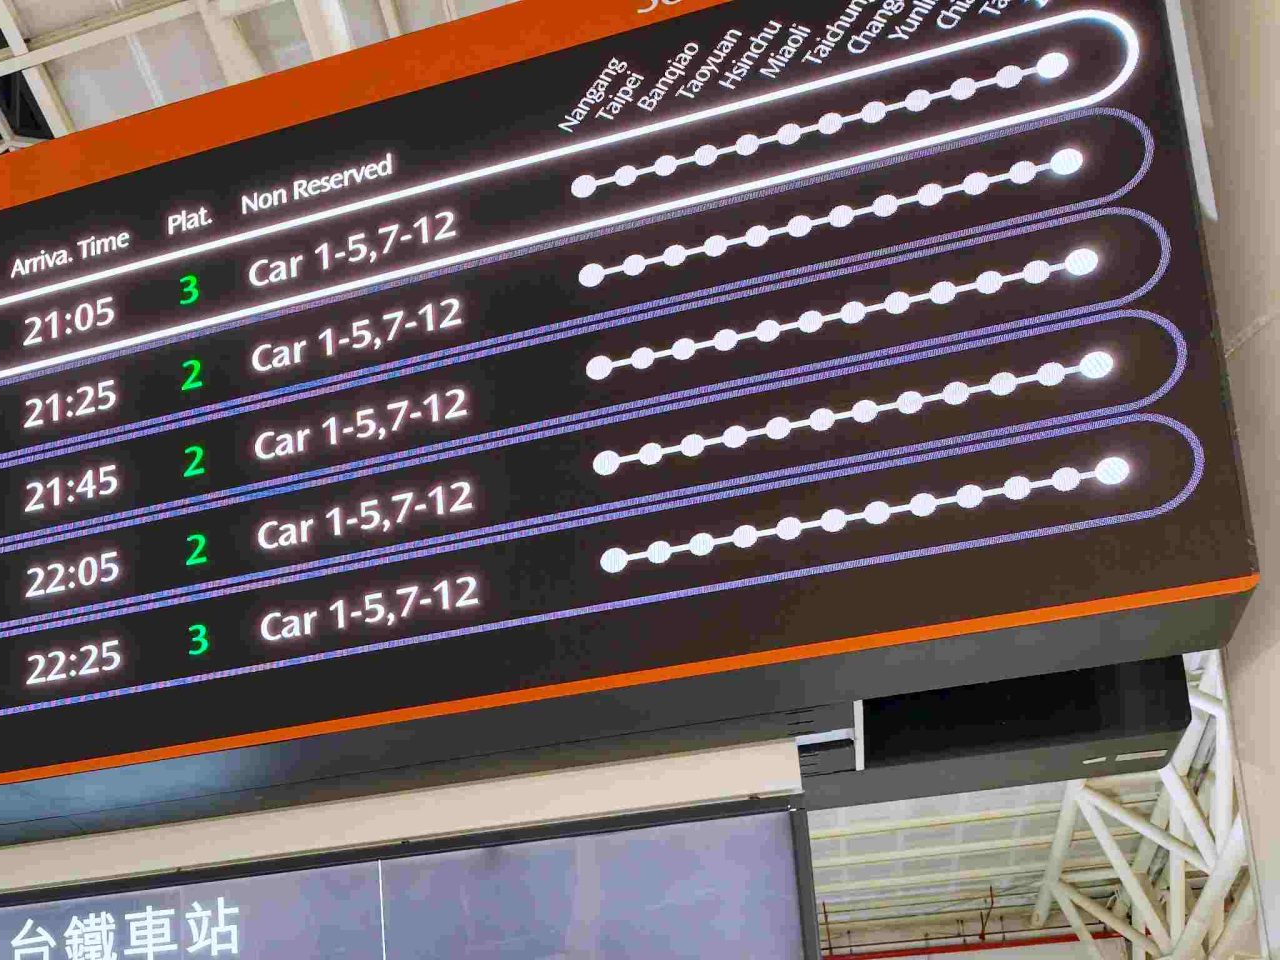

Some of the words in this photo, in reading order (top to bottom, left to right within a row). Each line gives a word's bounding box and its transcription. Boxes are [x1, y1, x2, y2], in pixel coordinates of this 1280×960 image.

[718, 20, 783, 90] Hsinchu
[759, 22, 812, 79] Miaoli
[847, 0, 905, 54] Chang
[557, 56, 628, 133] Nangang
[594, 70, 645, 121] Taipei
[637, 42, 699, 112] Banqiao
[675, 27, 743, 99] Taoyuan
[241, 188, 288, 215] Non
[293, 153, 392, 199] Reserved
[10, 249, 74, 279] Arriva.
[76, 231, 130, 260] Time
[167, 206, 213, 235] Plat.
[22, 296, 115, 346] 21:05
[179, 274, 200, 305] 3
[248, 254, 304, 287] Car
[315, 210, 457, 271] 1-5,7-12
[23, 379, 117, 429] 21:25
[181, 359, 204, 391] 2
[251, 339, 307, 372] Car
[318, 297, 463, 358] 1-5,7-12
[24, 464, 118, 513] 21:45
[183, 445, 206, 478] 2
[254, 428, 311, 460] Car
[321, 388, 467, 446] 1-5,7-12
[25, 551, 120, 598] 22:05
[185, 533, 208, 566] 2
[257, 518, 314, 550] Car
[325, 478, 474, 541] 1-5,7-12
[25, 639, 121, 685] 22:25
[189, 624, 209, 656] 3
[260, 610, 318, 641] Car
[329, 575, 480, 629] 1-5,7-12
